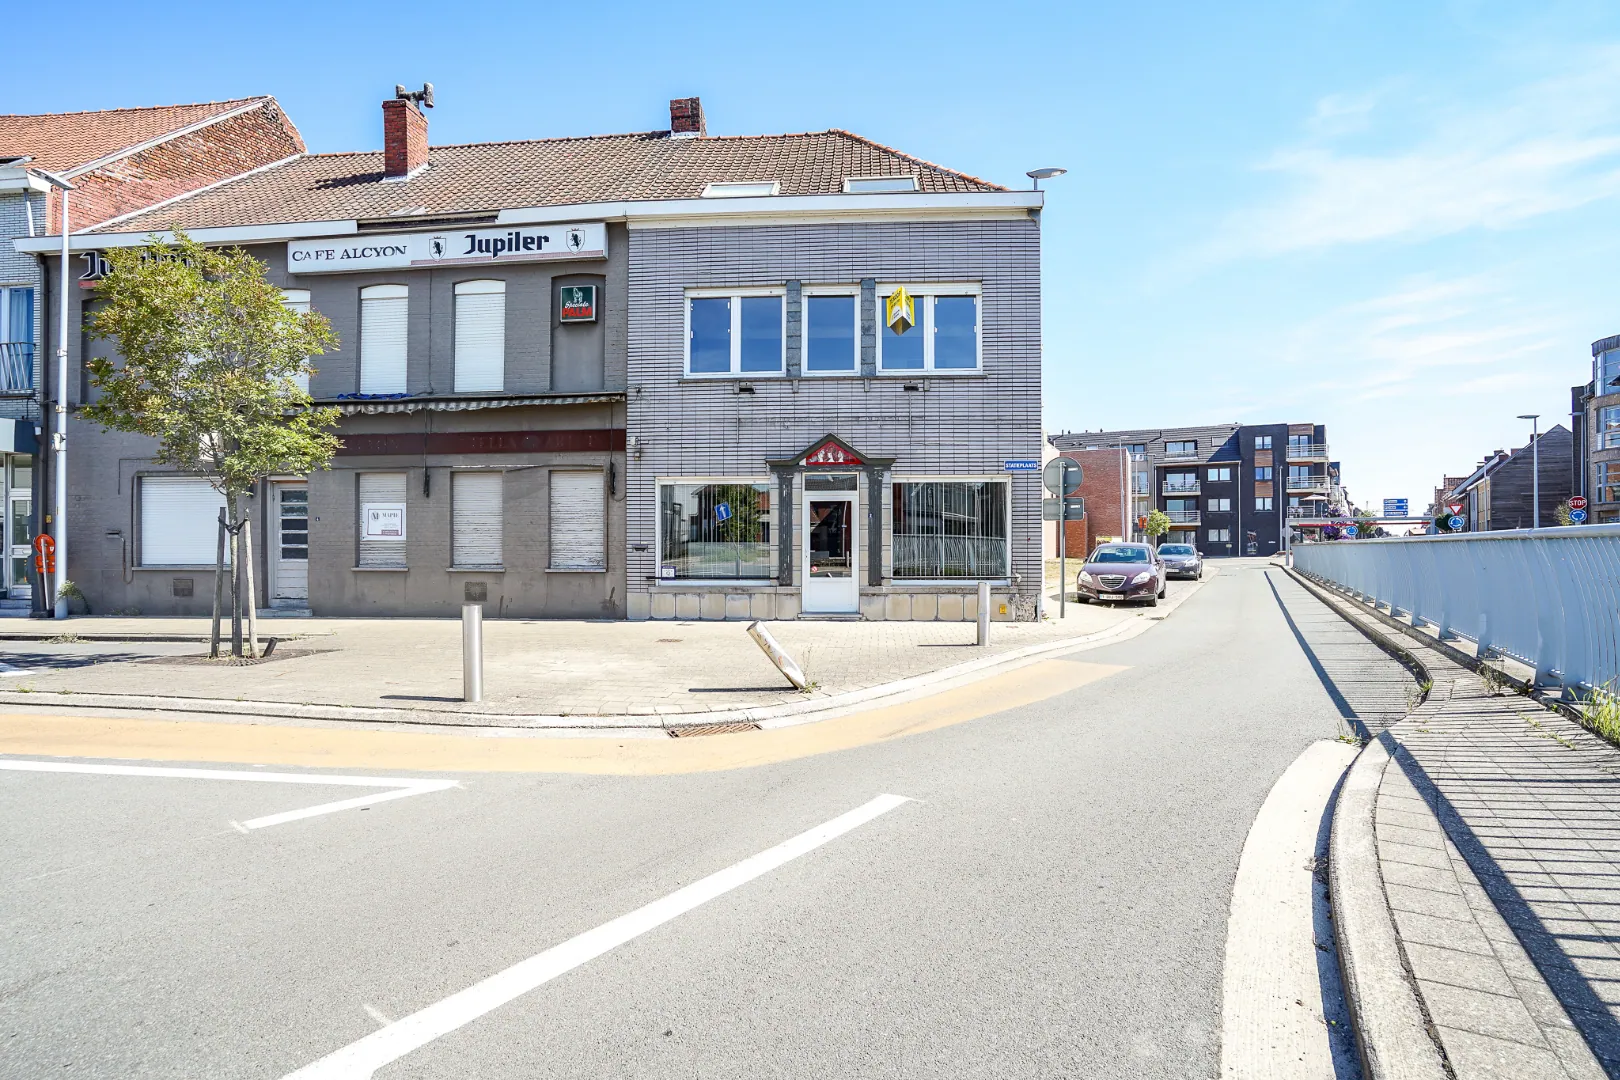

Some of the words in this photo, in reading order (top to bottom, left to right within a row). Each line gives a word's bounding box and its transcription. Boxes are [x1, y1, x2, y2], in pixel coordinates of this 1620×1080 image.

[463, 231, 549, 258] Jupiler
[292, 248, 335, 262] CAFE
[340, 245, 407, 260] ALCYON
[562, 306, 593, 318] PALM
